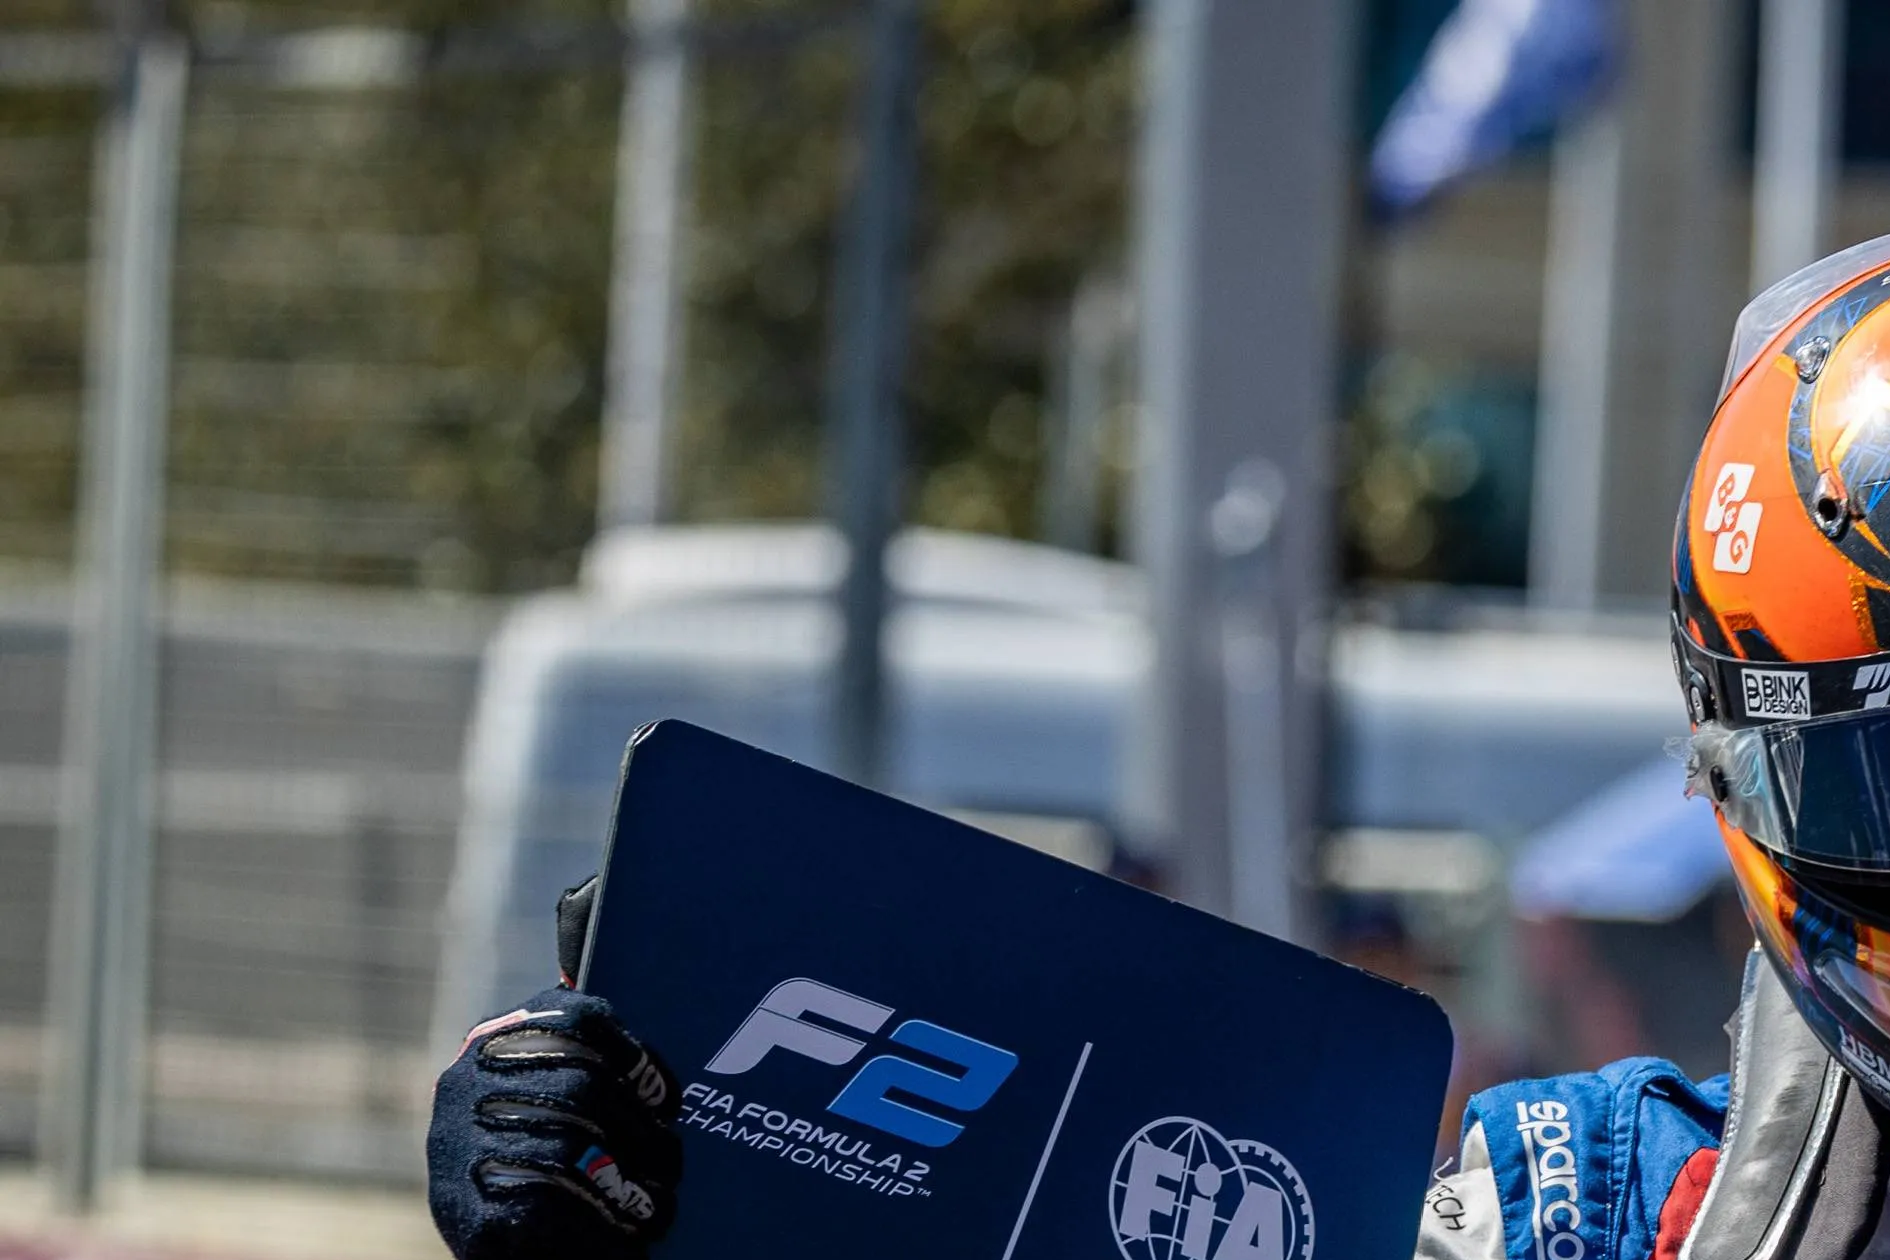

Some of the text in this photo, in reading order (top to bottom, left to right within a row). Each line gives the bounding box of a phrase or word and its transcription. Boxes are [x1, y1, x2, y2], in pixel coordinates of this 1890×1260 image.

[1761, 675, 1806, 701] BINK
[1764, 699, 1808, 715] DESIGN
[705, 977, 1019, 1148] F2
[682, 1082, 931, 1181] FIA FORMULA 2
